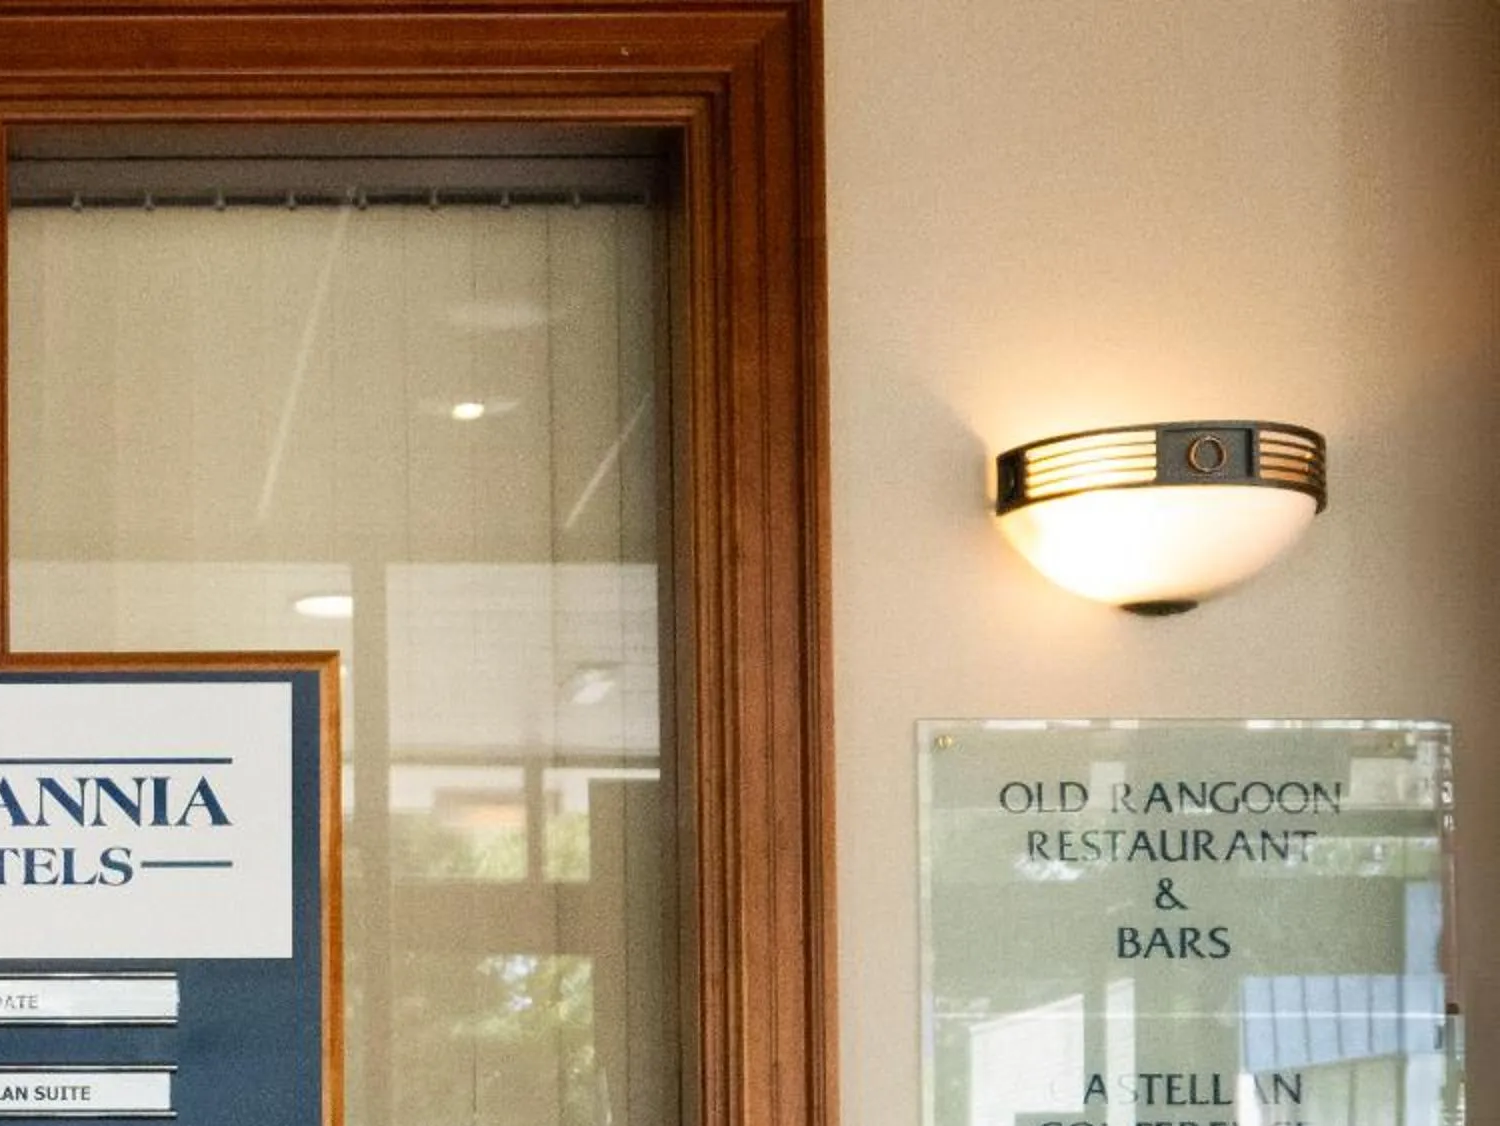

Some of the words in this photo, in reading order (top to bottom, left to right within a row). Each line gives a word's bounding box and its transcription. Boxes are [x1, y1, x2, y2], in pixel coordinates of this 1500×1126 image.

[999, 781, 1088, 814] OLD
[1111, 780, 1342, 815] RANGOON
[1027, 829, 1317, 862] RESTAURANT
[1155, 876, 1188, 911] &
[1117, 927, 1231, 959] BARS
[33, 1085, 91, 1102] SUITE
[1049, 1072, 1302, 1105] ASTELLN
